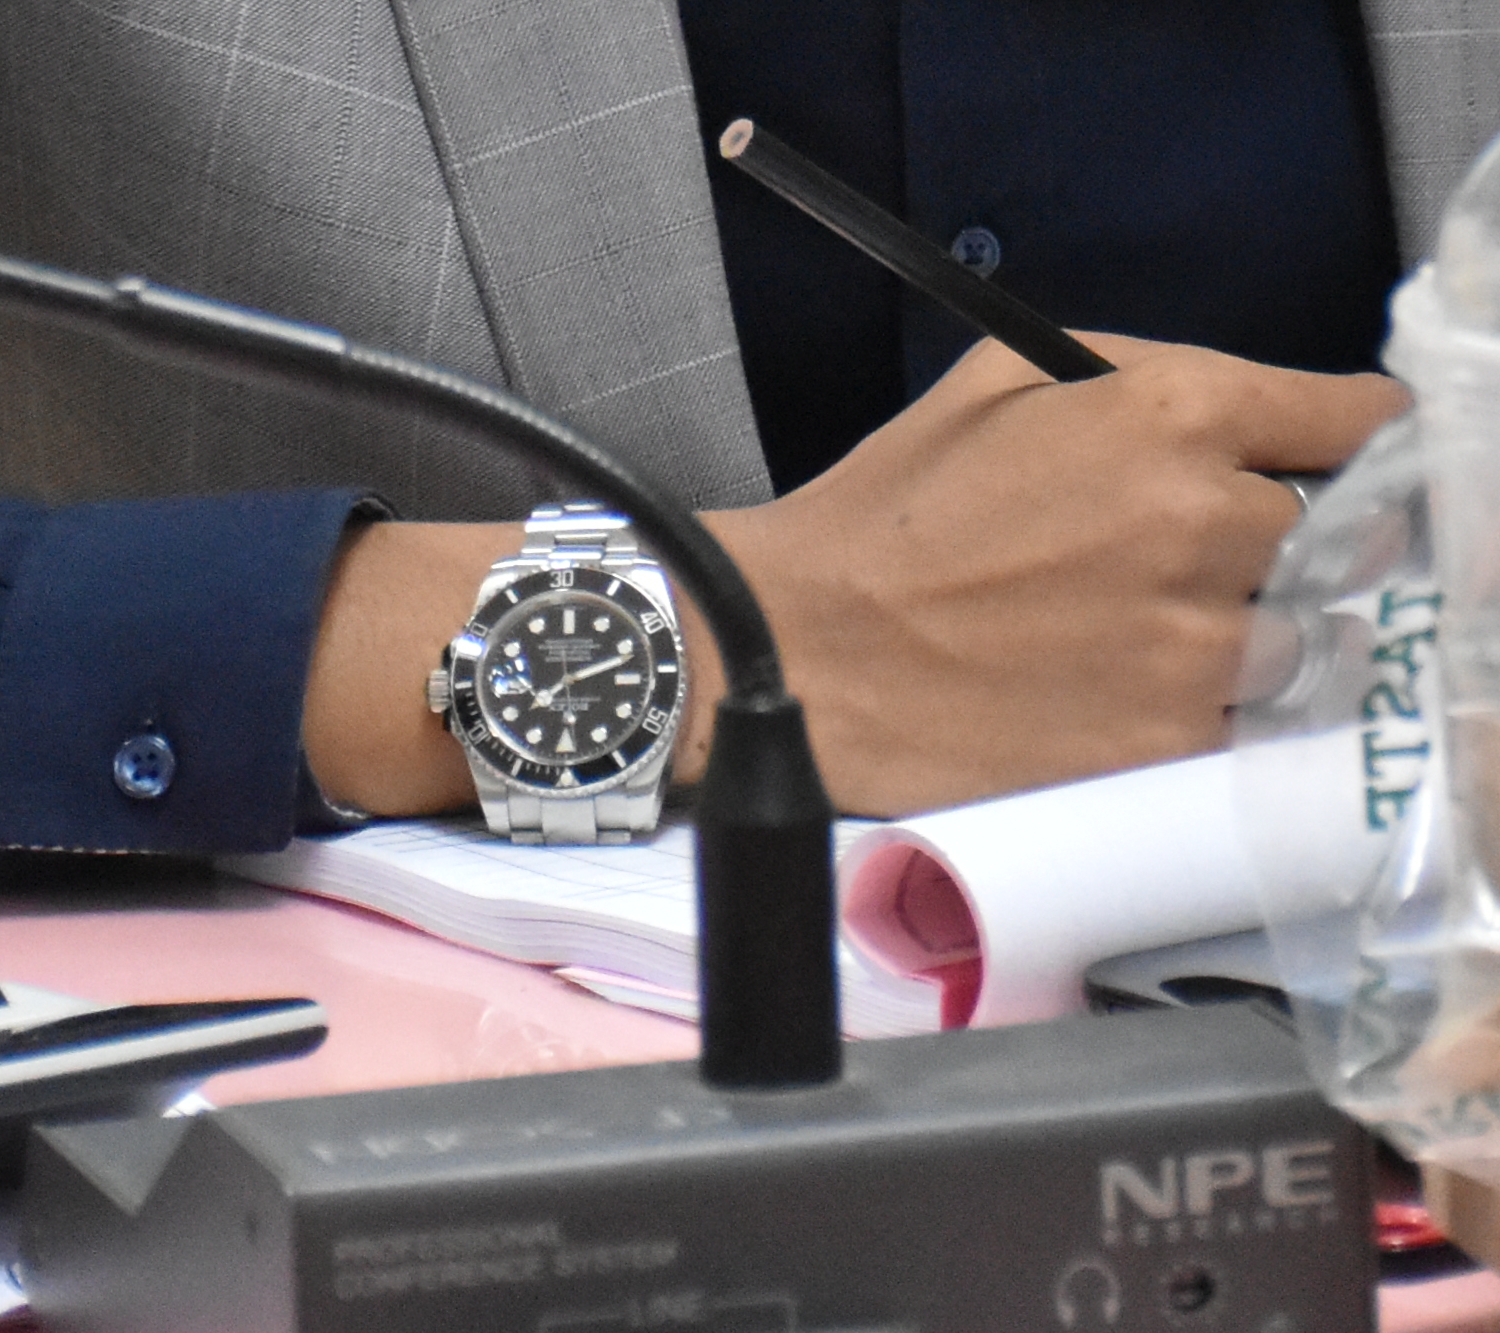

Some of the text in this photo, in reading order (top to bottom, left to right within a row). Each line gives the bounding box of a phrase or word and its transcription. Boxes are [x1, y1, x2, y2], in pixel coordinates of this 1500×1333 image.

[549, 570, 575, 588] 30
[640, 611, 664, 634] 40
[467, 721, 491, 747] 10
[642, 708, 669, 735] 50
[1100, 1141, 1337, 1220] NPE
